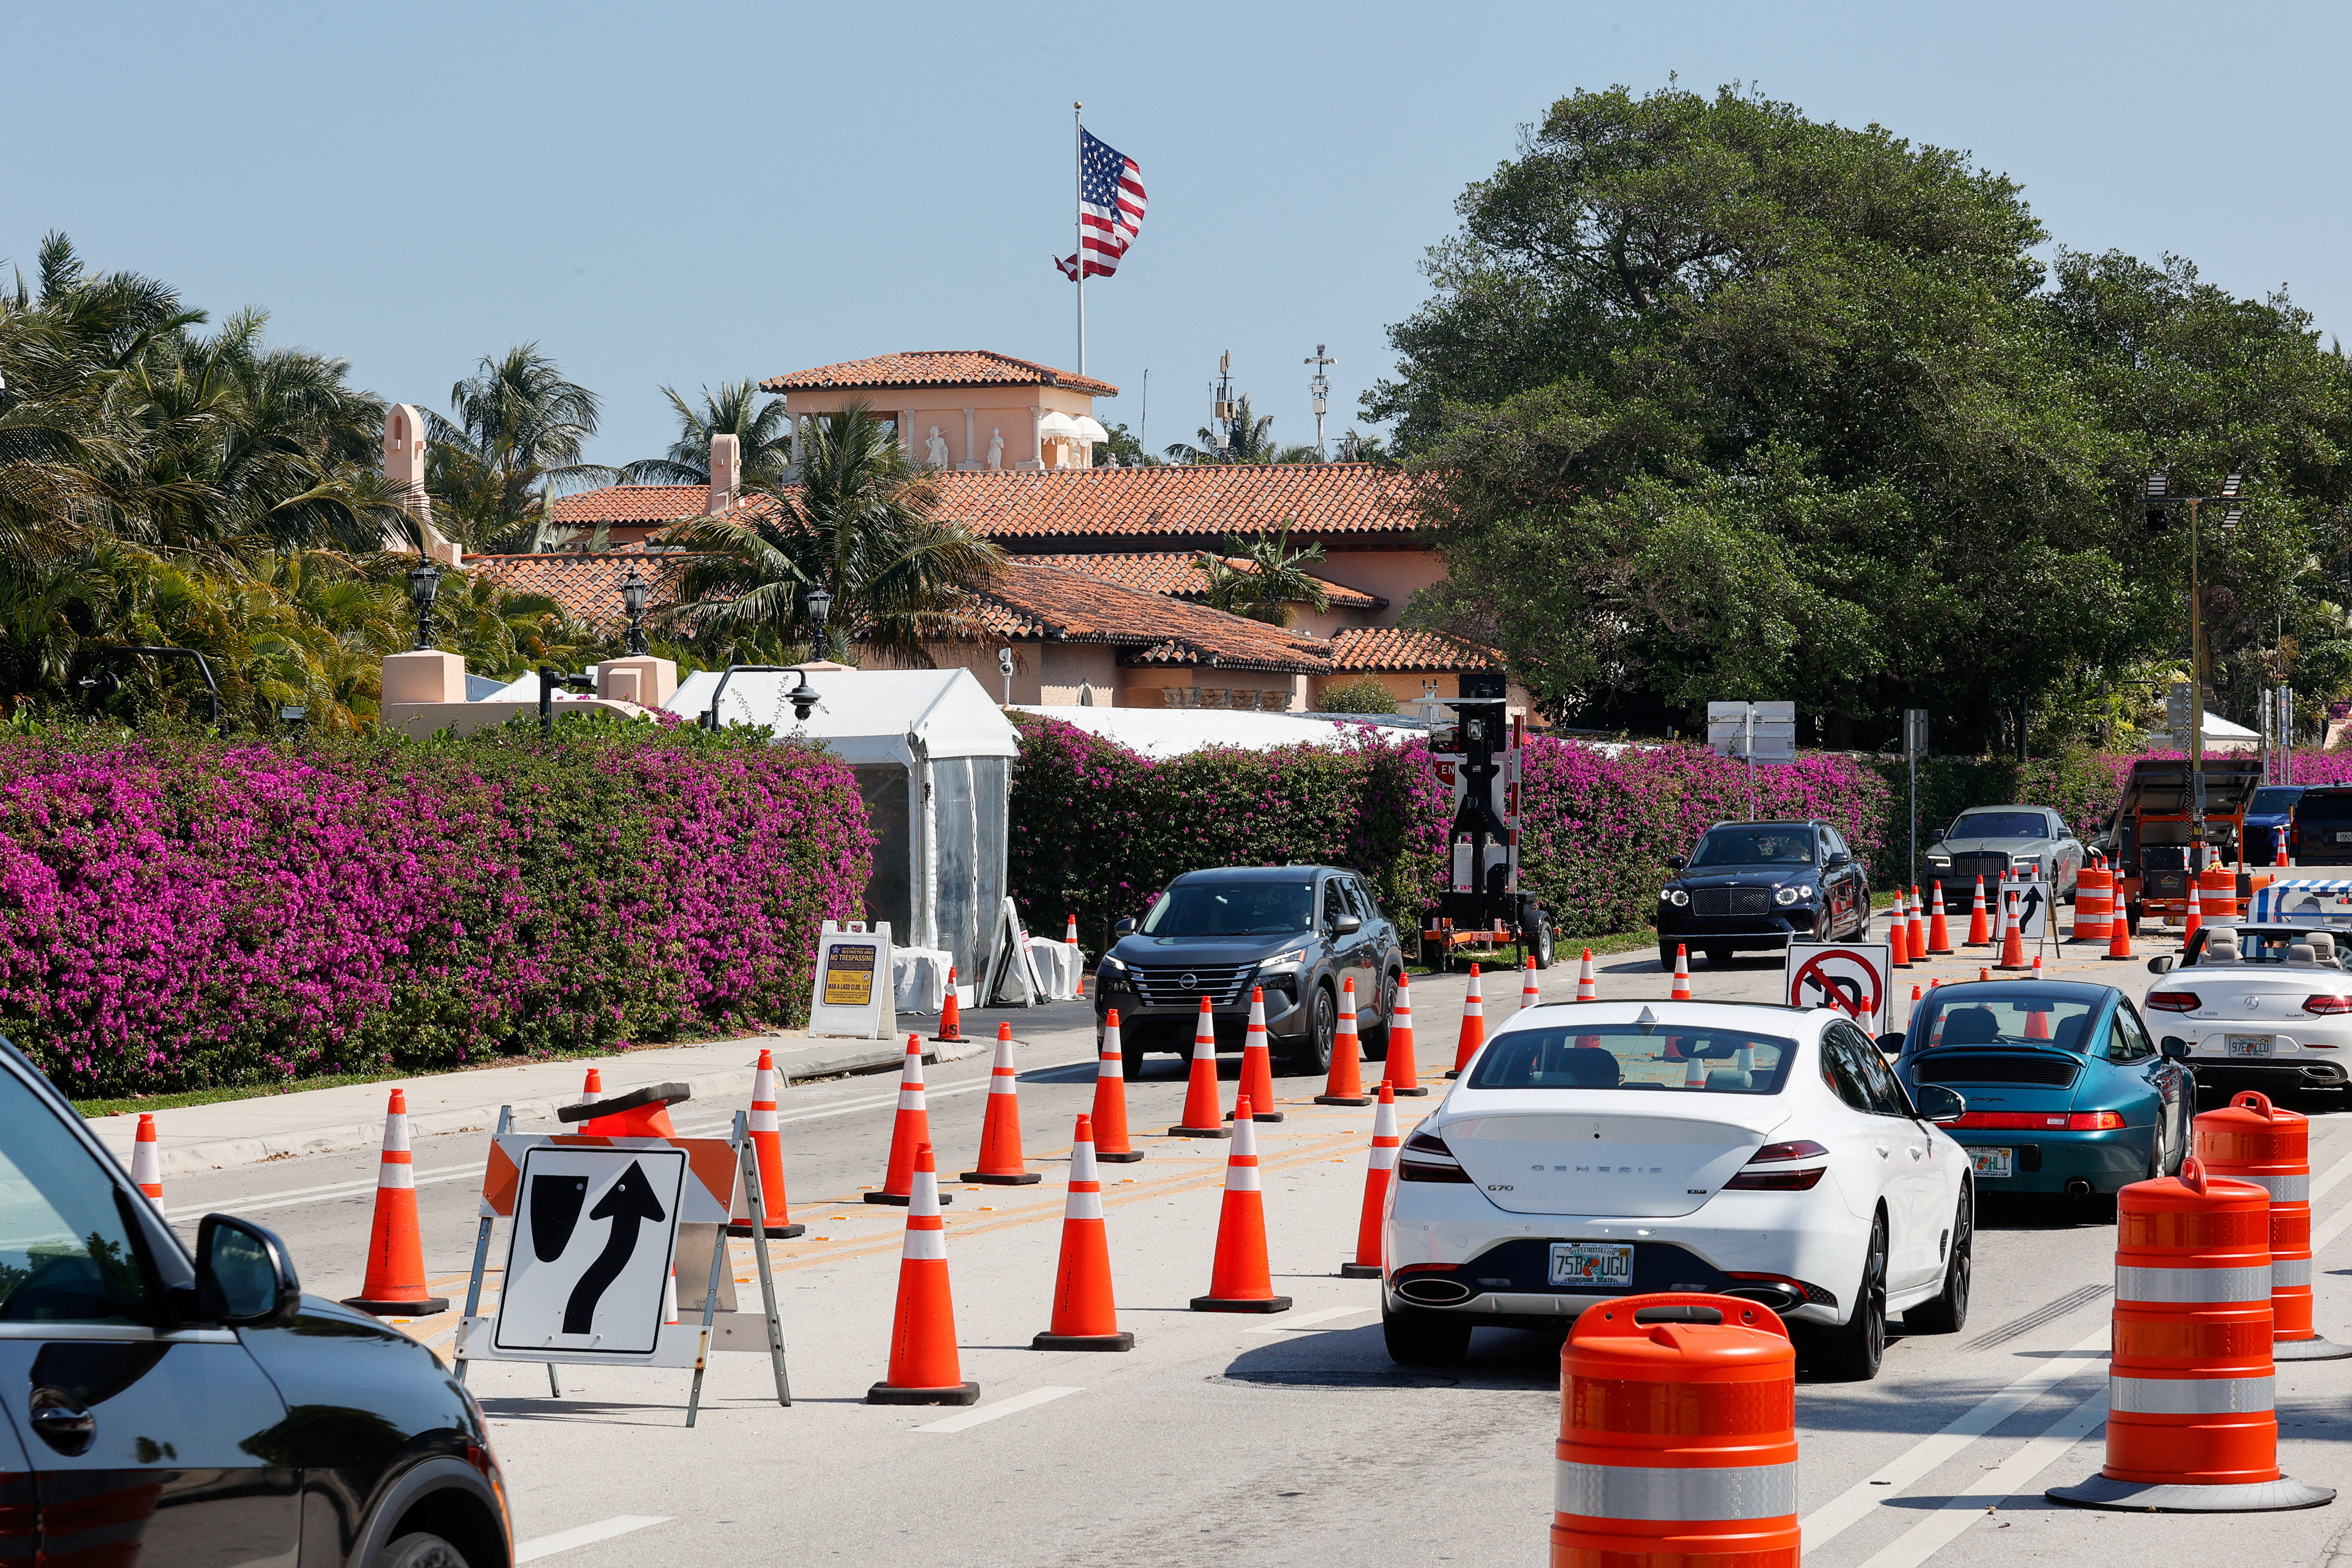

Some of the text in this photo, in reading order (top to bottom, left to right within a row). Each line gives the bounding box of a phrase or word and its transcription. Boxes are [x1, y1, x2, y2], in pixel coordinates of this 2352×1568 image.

[2232, 1042, 2269, 1053] 97E CCU
[1988, 1156, 2008, 1170] HLI
[1531, 1165, 1663, 1173] GENESIS
[1569, 1247, 1616, 1256] MYFLORIDA.COM
[1556, 1256, 1628, 1276] 75B UGU
